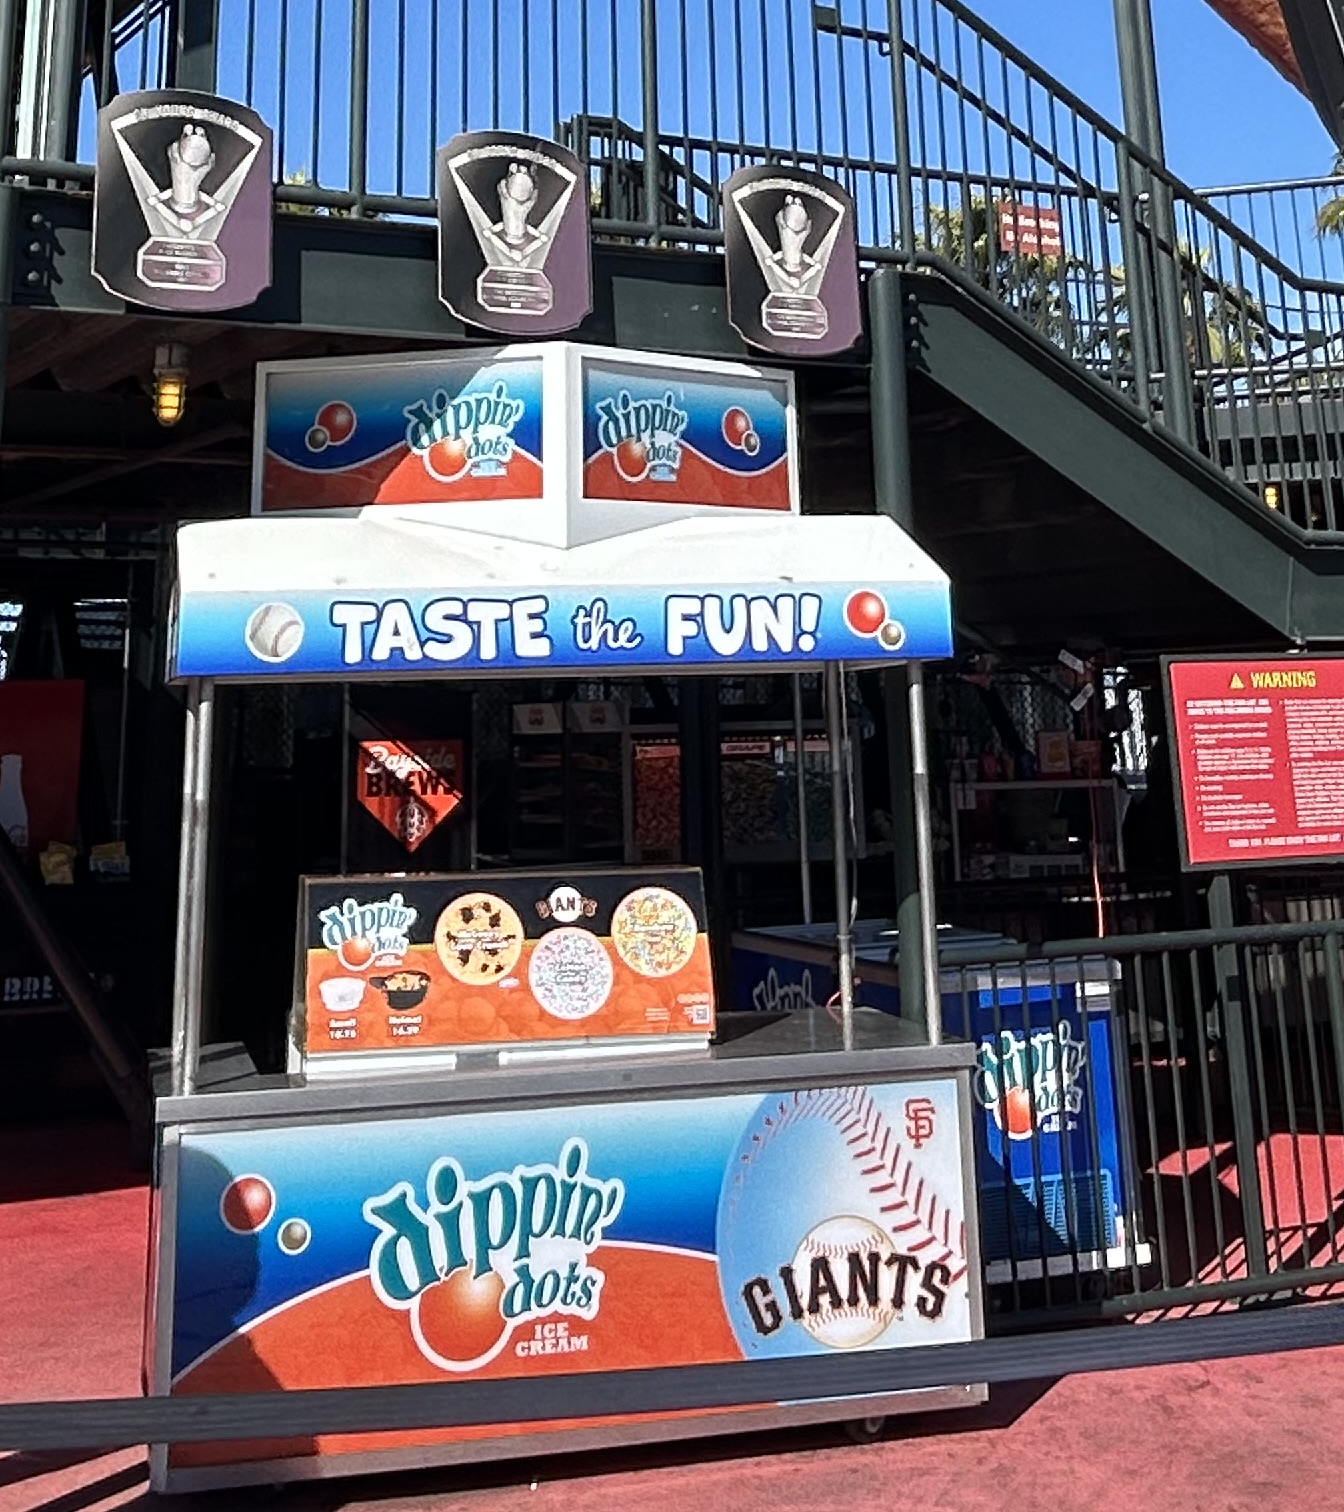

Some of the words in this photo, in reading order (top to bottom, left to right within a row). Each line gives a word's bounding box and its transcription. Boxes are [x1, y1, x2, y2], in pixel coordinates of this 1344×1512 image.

[466, 434, 511, 460] dots
[331, 595, 552, 664] TASTE
[571, 600, 642, 652] the
[664, 594, 822, 656] FUN!
[1250, 670, 1316, 688] WARNING
[369, 1144, 623, 1303] dippin'
[503, 1258, 598, 1320] dots
[741, 1250, 953, 1338] GIANTS
[515, 1334, 589, 1357] CREAM
[534, 1323, 570, 1340] ICE
